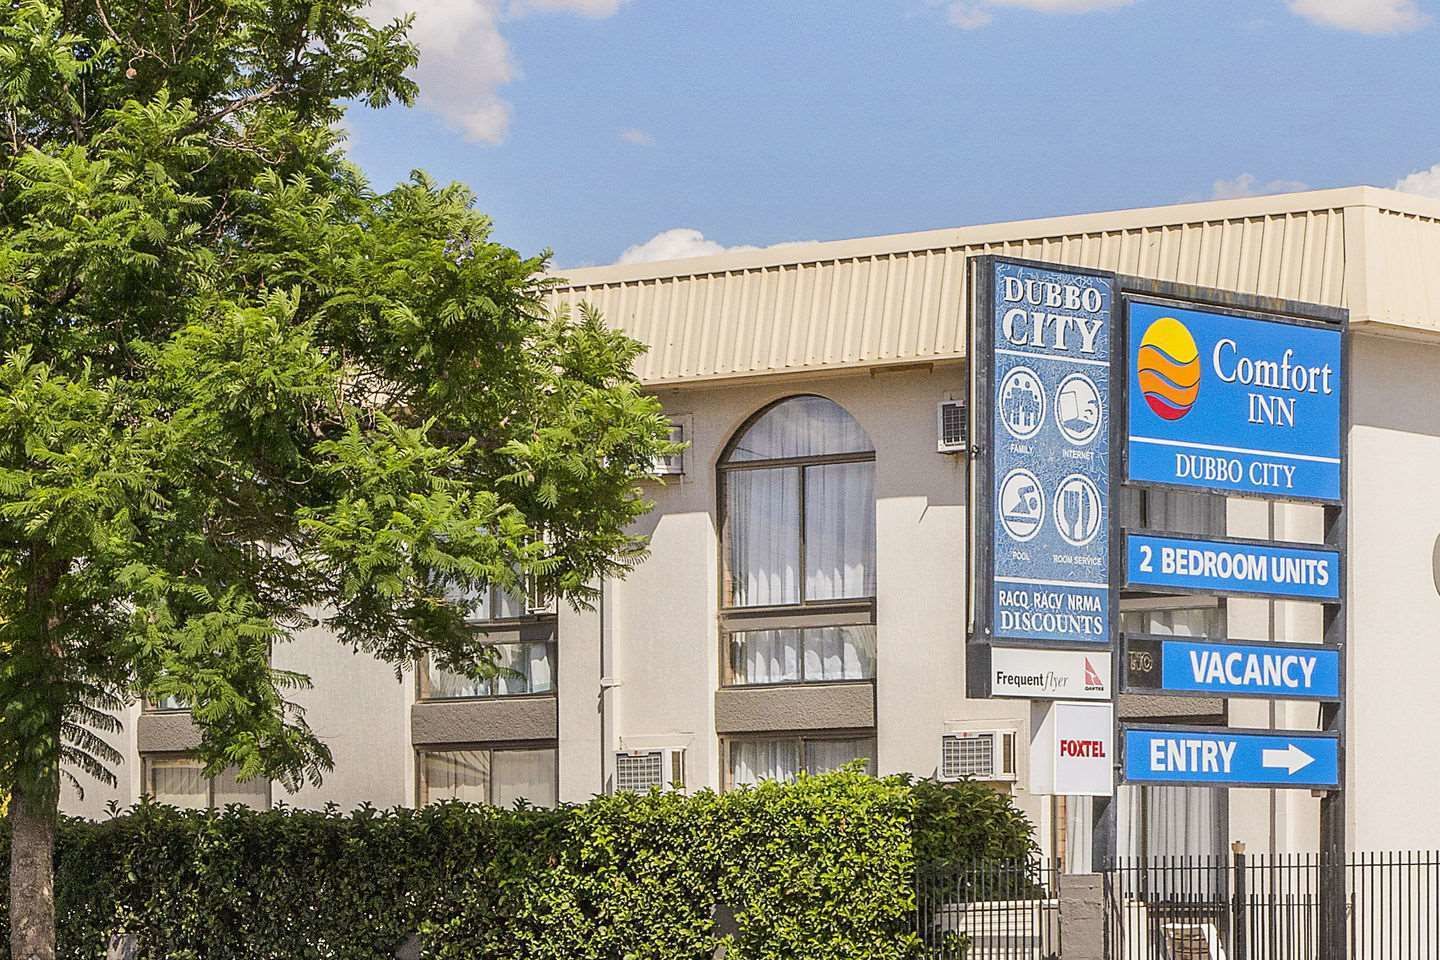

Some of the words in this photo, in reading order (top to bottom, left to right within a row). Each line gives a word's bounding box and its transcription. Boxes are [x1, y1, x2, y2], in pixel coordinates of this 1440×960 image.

[1003, 277, 1102, 313] DUBBO
[1003, 308, 1104, 353] CITY
[1213, 338, 1333, 395] Comfort
[1248, 393, 1296, 428] INN
[1009, 443, 1034, 454] FAMILY
[1062, 449, 1094, 460] INTERNET
[1175, 453, 1243, 483] DUBBO
[1249, 461, 1296, 488] CITY
[1012, 551, 1030, 561] POOL
[1053, 554, 1073, 564] ROOM
[1074, 555, 1103, 566] SERVICE
[1139, 545, 1153, 573] 2
[1161, 547, 1267, 582] BEDROOM
[1271, 556, 1329, 586] UNITS
[999, 590, 1030, 609] RACQ
[1033, 592, 1064, 609] RACV
[1067, 594, 1102, 612] NRMA
[1000, 611, 1103, 635] DISCOUNTS
[996, 671, 1043, 688] Frequent
[1189, 650, 1317, 688] VACANCY
[1060, 739, 1106, 758] FOXTEL
[1150, 739, 1237, 773] ENTRY
